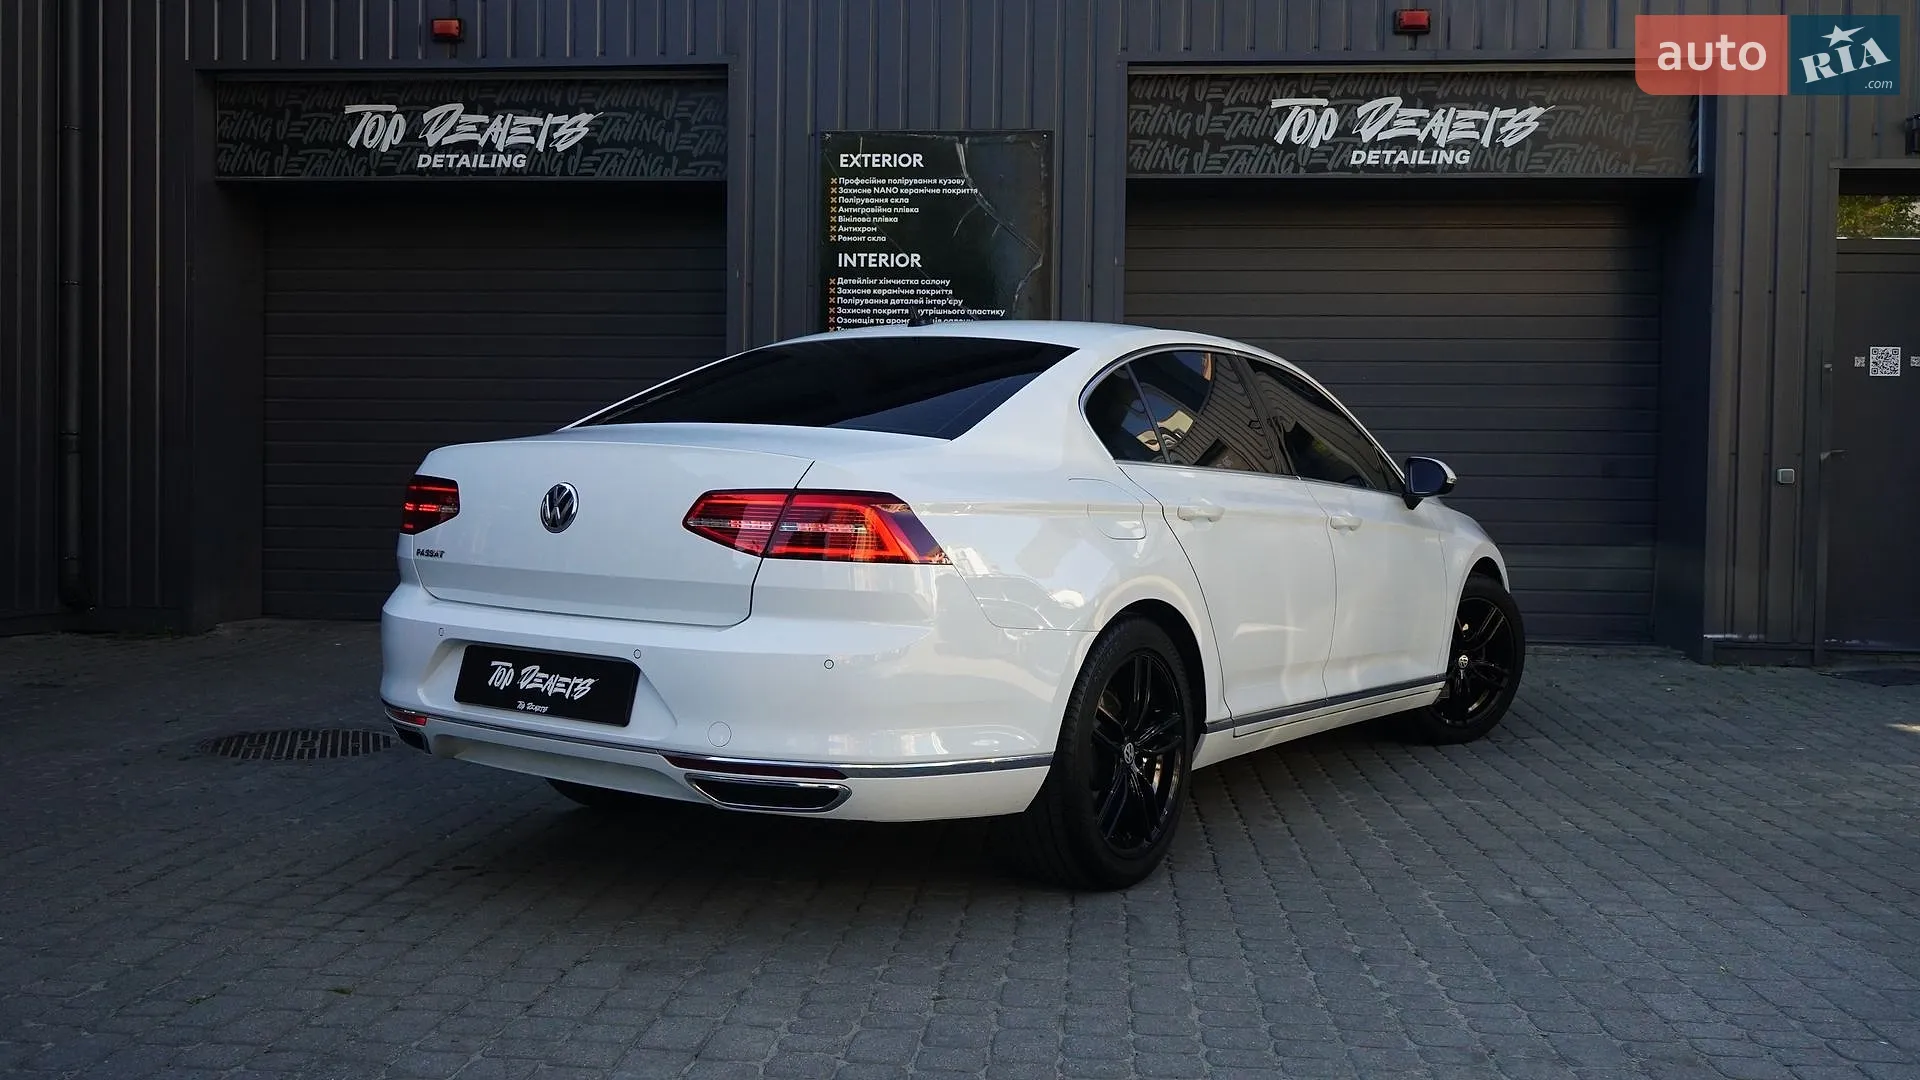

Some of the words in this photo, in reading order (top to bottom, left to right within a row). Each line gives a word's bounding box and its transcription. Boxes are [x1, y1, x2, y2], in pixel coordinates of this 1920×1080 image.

[417, 154, 527, 168] DETAILING
[839, 153, 924, 168] EXTERIOR
[1350, 149, 1471, 165] DETAILING
[838, 177, 886, 186] Професійне
[888, 177, 937, 186] полірування
[938, 178, 965, 186] кузову
[899, 187, 941, 195] керамічне
[942, 187, 978, 195] покриття
[838, 196, 889, 204] Полірування
[838, 206, 892, 214] Антигравійна
[837, 252, 922, 268] INTERIOR
[837, 277, 878, 286] Детейлінг
[878, 277, 919, 285] хімчистка
[920, 278, 951, 287] салону
[837, 287, 871, 295] Захисне
[872, 287, 915, 296] керамічне
[916, 288, 953, 296] покриття
[837, 297, 888, 306] Полірування
[889, 297, 924, 306] деталей
[836, 307, 871, 315] Захисне
[872, 308, 909, 316] покриття
[966, 309, 1006, 317] пластику
[836, 316, 874, 325] Озонація
[416, 548, 446, 559] PASSAT
